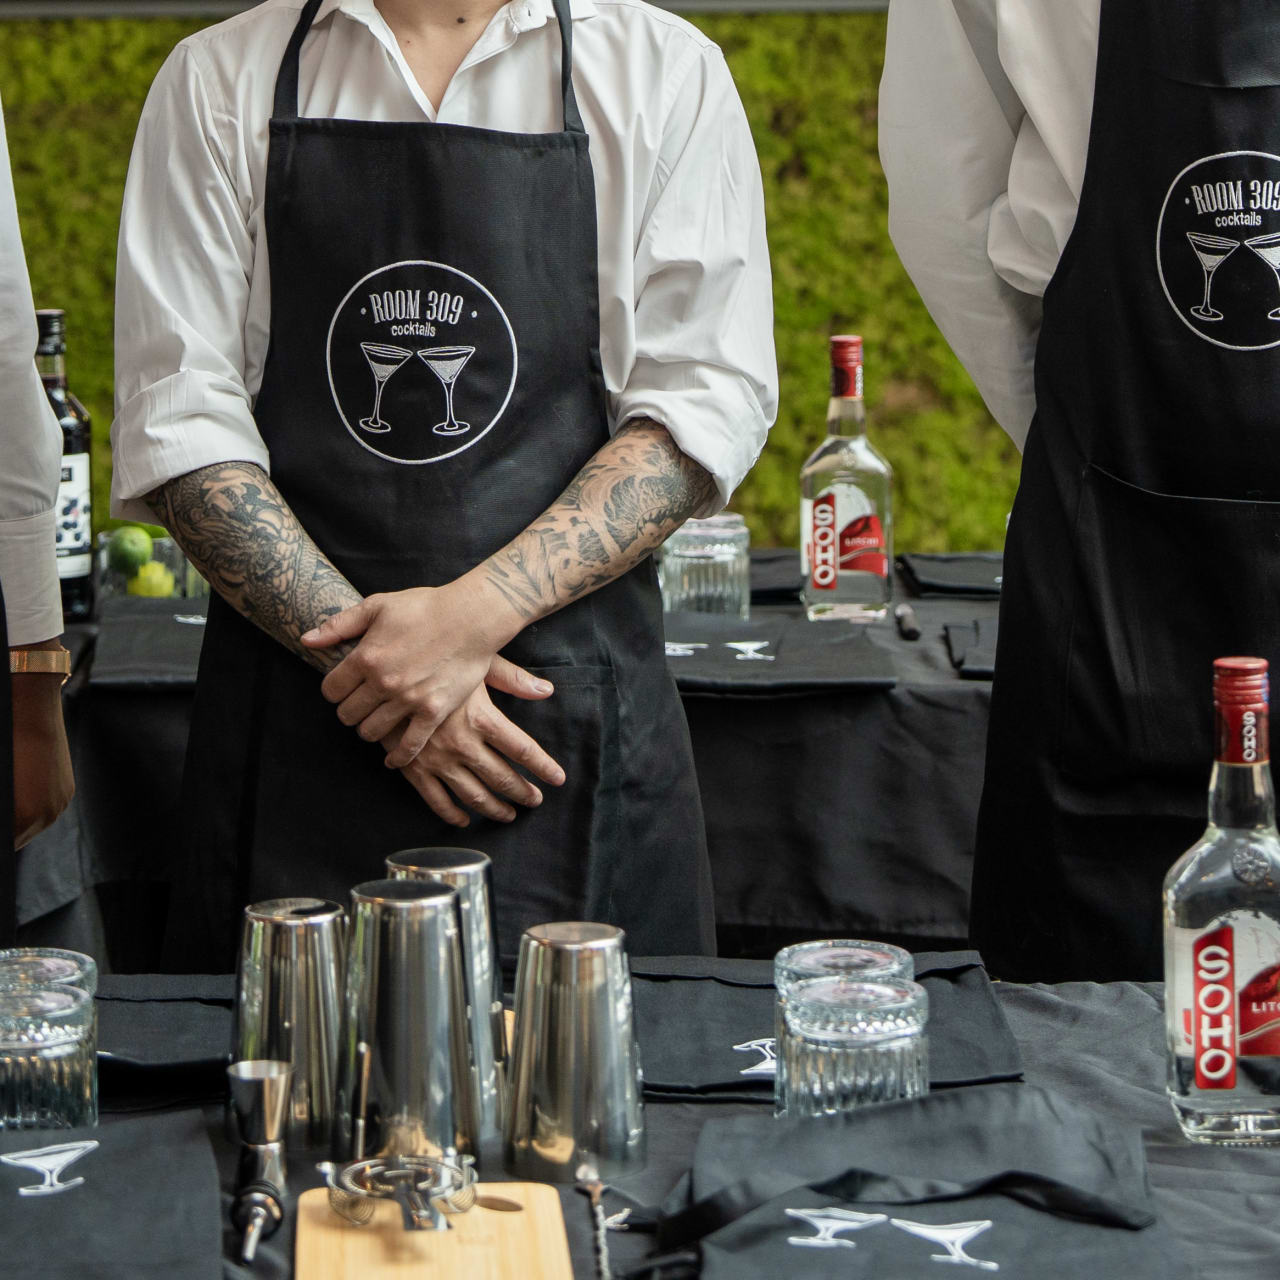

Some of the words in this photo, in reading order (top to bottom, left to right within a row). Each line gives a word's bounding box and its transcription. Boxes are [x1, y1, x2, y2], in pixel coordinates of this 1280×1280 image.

[1191, 180, 1244, 214] ROOM
[1215, 211, 1262, 227] cocktails
[369, 289, 421, 324] ROOM
[426, 290, 464, 325] 309
[391, 321, 436, 337] cocktails
[814, 503, 835, 585] SOHO
[1242, 711, 1256, 762] SOHO
[1198, 945, 1233, 1080] SOHO
